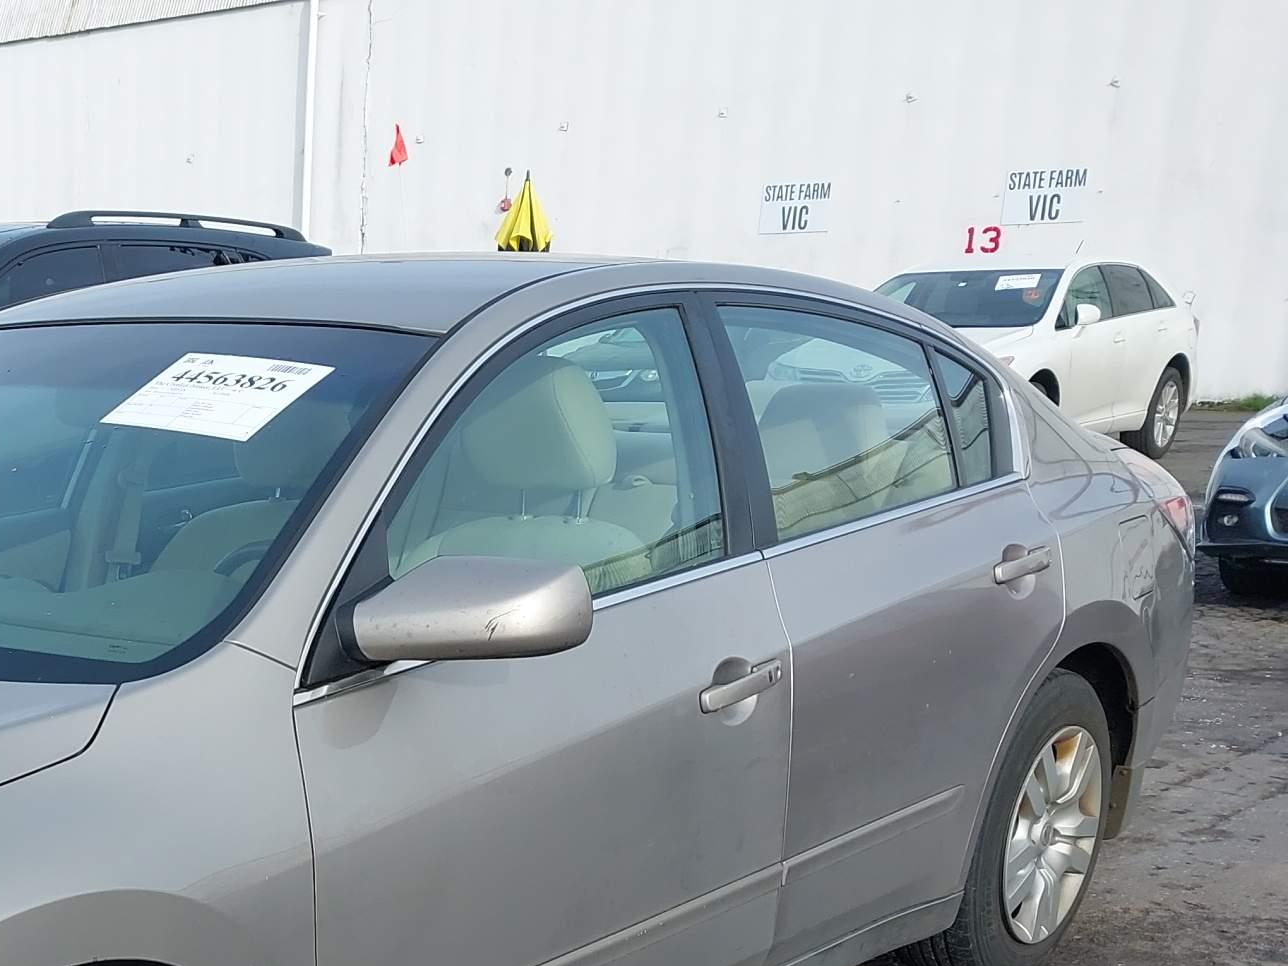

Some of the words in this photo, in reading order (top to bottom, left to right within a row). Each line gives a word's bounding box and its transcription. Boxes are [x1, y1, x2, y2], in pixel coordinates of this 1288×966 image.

[764, 184, 796, 202] STATE
[798, 182, 831, 201] FARM
[1008, 170, 1046, 191] STATE
[1048, 168, 1088, 188] FARM
[781, 205, 809, 231] VIC
[1028, 193, 1062, 221] VIC
[964, 226, 1002, 254] 13
[171, 369, 297, 393] 44563826
